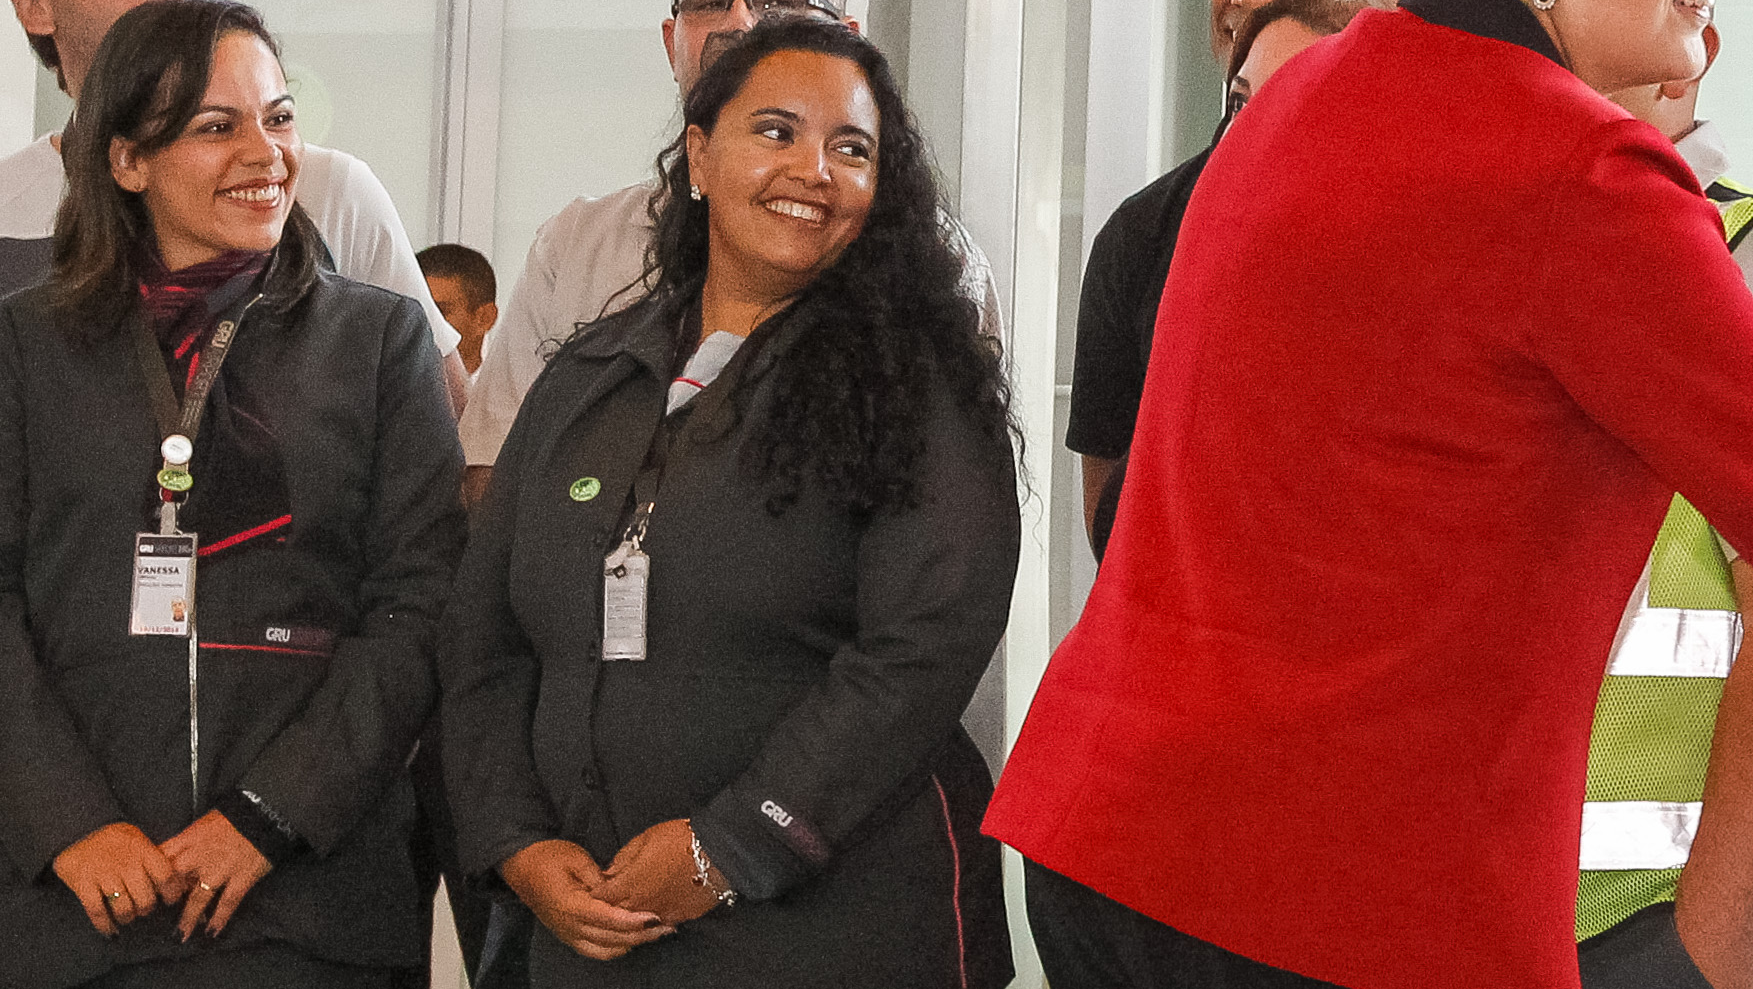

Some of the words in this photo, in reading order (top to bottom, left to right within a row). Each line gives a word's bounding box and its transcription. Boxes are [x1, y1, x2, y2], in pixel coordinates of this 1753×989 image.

[138, 566, 181, 575] VANESSA
[265, 627, 291, 642] GRU
[761, 800, 794, 827] GRU
